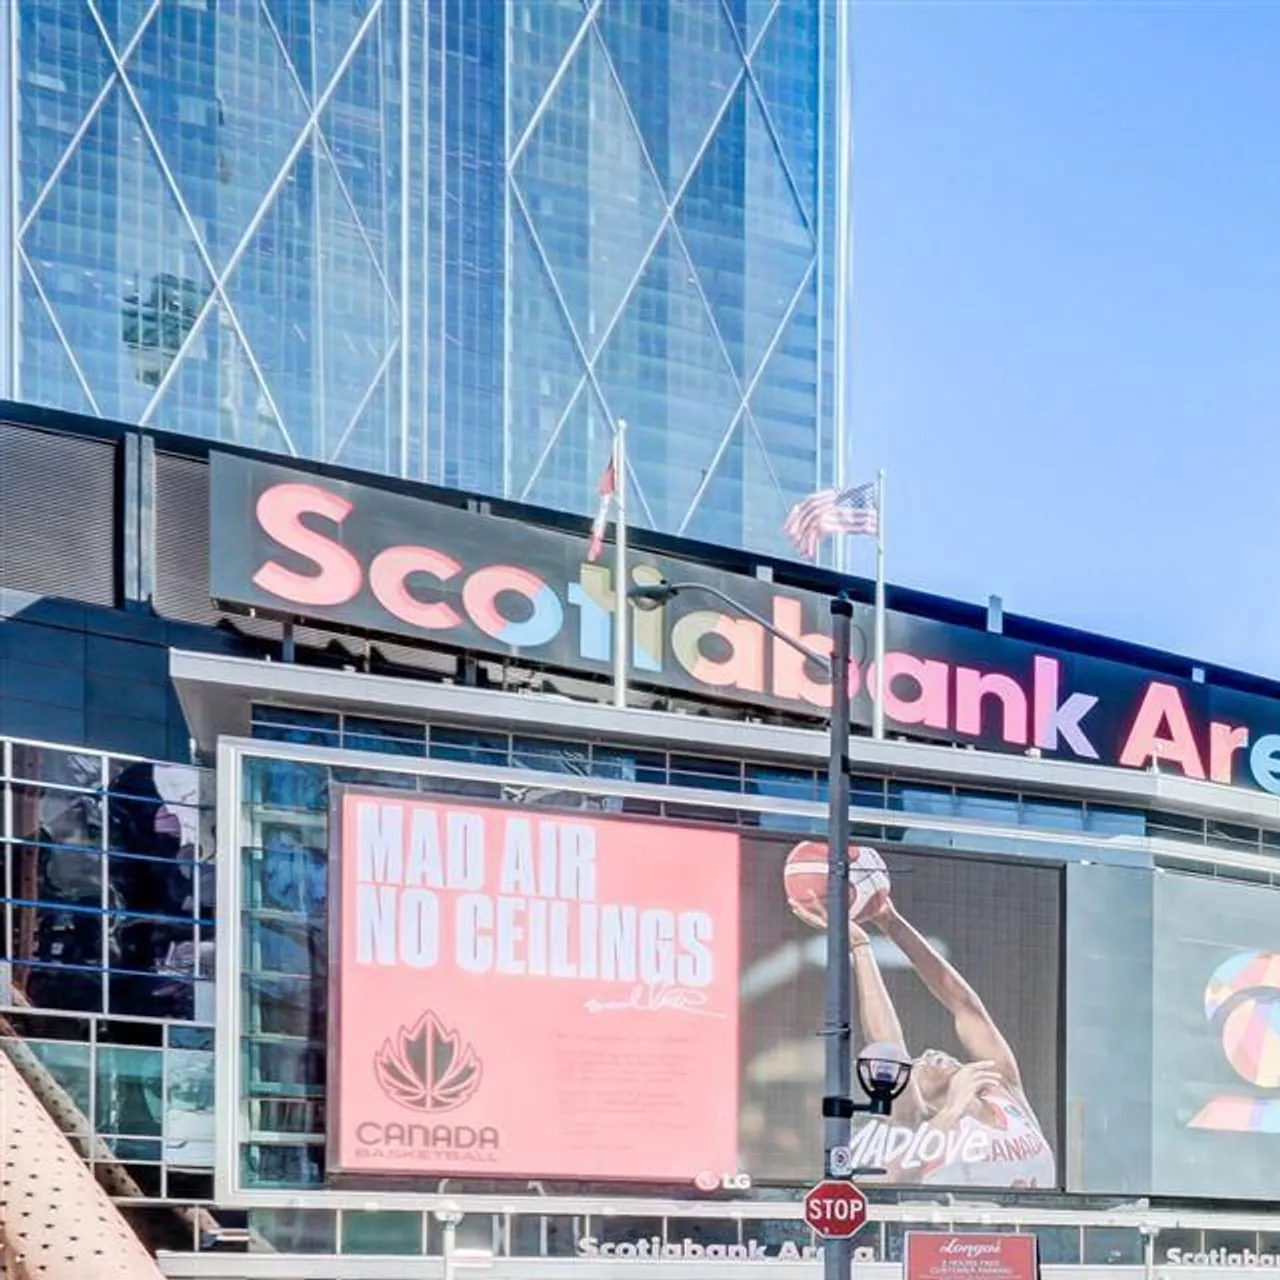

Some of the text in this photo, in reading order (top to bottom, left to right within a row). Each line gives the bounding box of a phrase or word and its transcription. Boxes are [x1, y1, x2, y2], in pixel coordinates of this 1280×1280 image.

[252, 484, 1099, 759] Scotiabank
[355, 802, 597, 900] MAD AIR
[356, 885, 714, 988] NO CEILINGS
[355, 1122, 499, 1149] CANADA
[355, 1148, 498, 1162] BASKETBALL
[722, 1173, 751, 1190] LG
[808, 1200, 864, 1220] STOP
[577, 1236, 875, 1262] Scotiabank Ara
